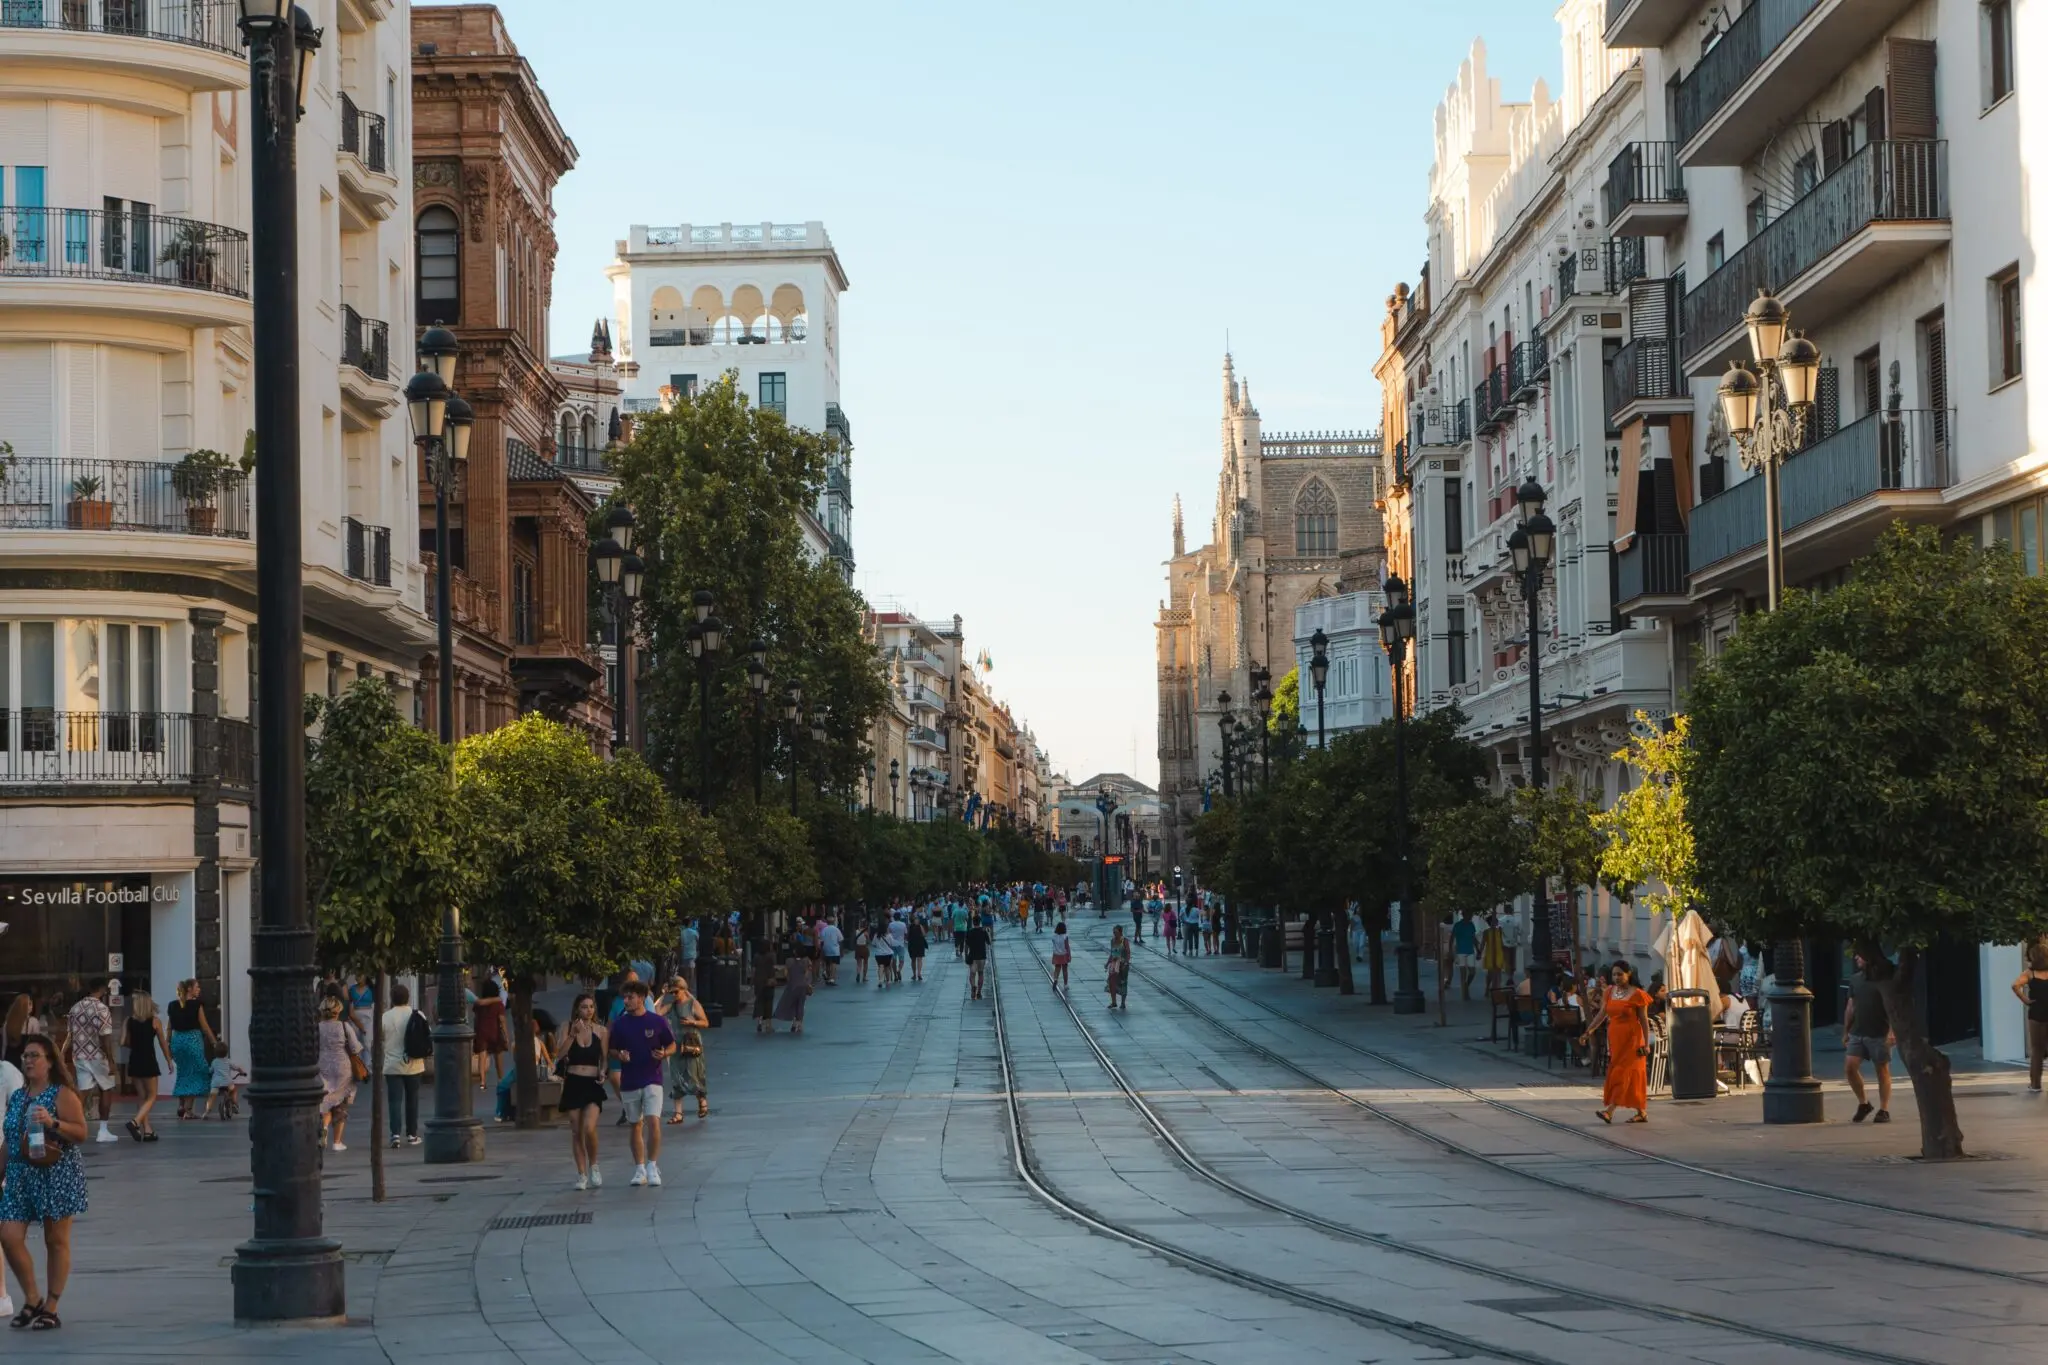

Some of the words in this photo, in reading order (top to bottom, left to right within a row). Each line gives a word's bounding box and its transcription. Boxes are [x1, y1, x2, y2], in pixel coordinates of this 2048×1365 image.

[21, 888, 81, 905] Sevilla
[86, 885, 149, 904] Football
[152, 884, 180, 902] Club
